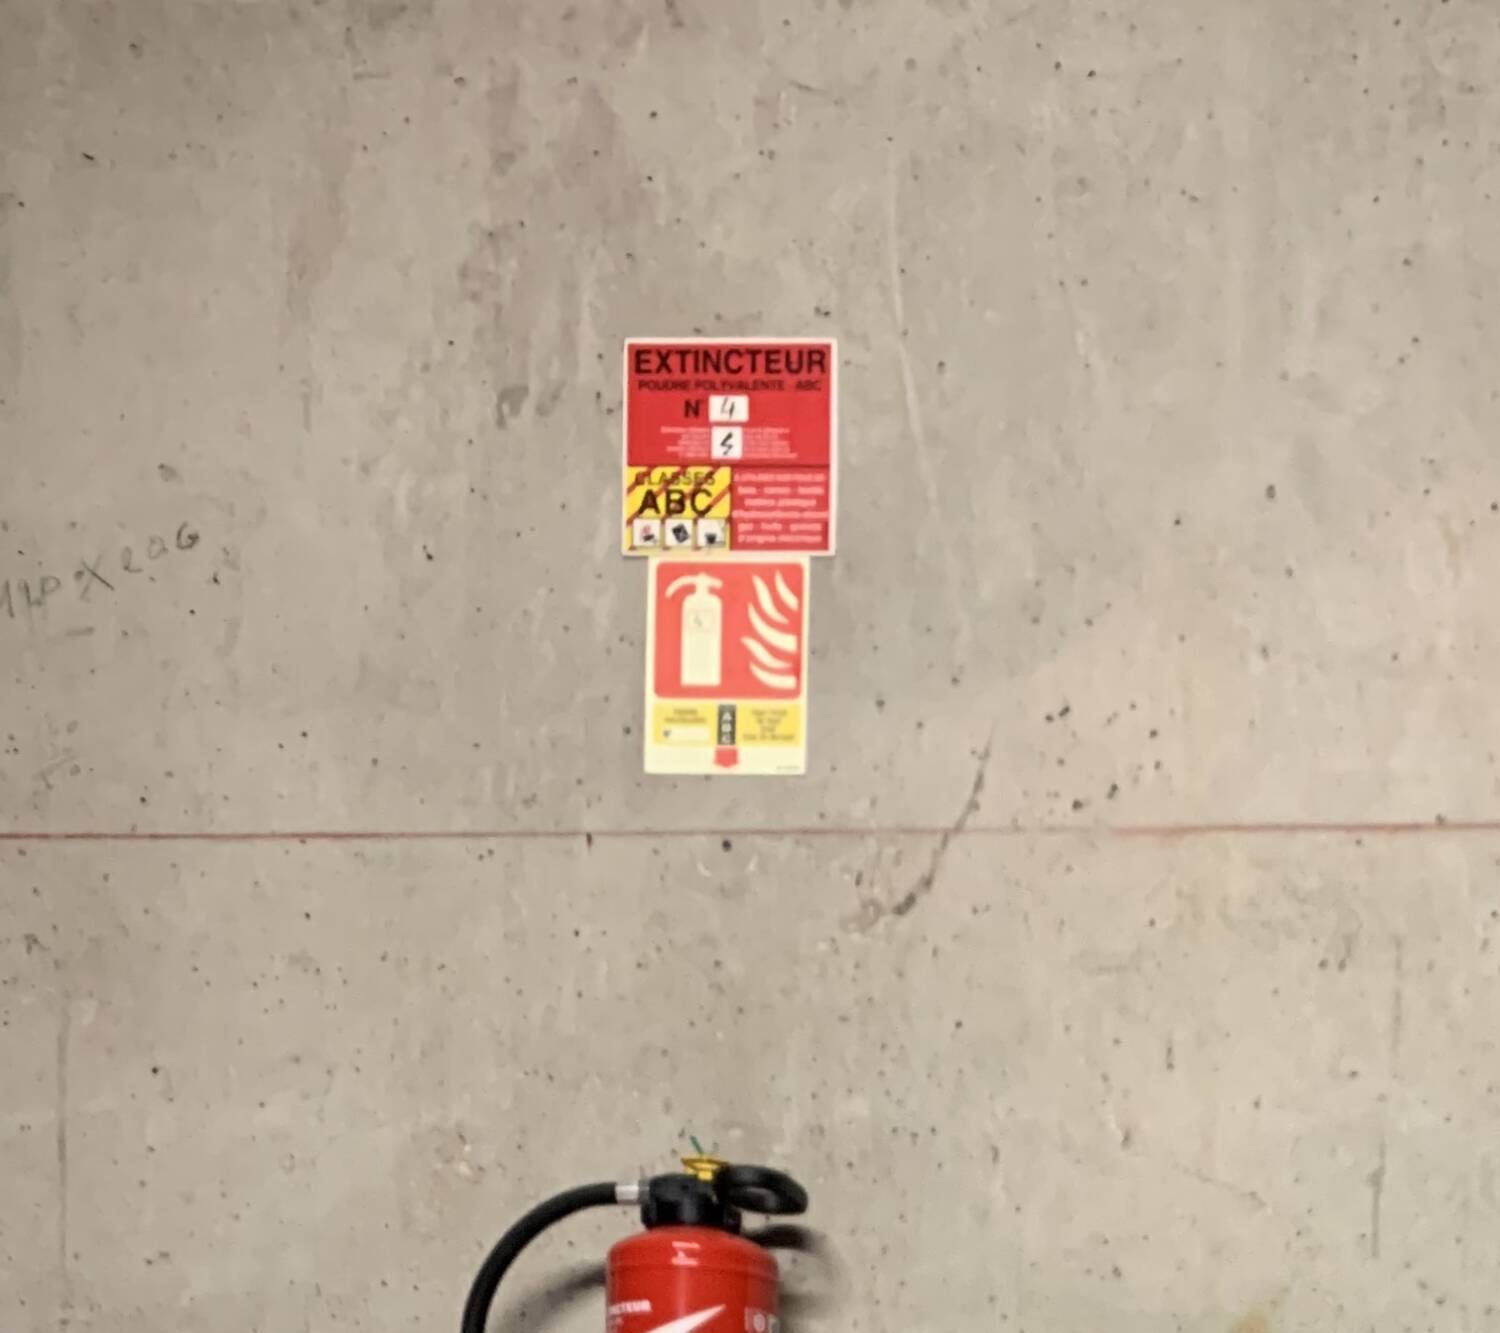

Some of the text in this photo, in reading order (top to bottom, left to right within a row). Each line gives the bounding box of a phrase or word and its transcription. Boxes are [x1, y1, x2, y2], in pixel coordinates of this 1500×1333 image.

[634, 349, 826, 375] EXTINCTEUR
[637, 379, 822, 392] POUDRE POLYVALENTE ABC
[636, 471, 716, 486] CLASSES
[637, 488, 713, 515] ABC
